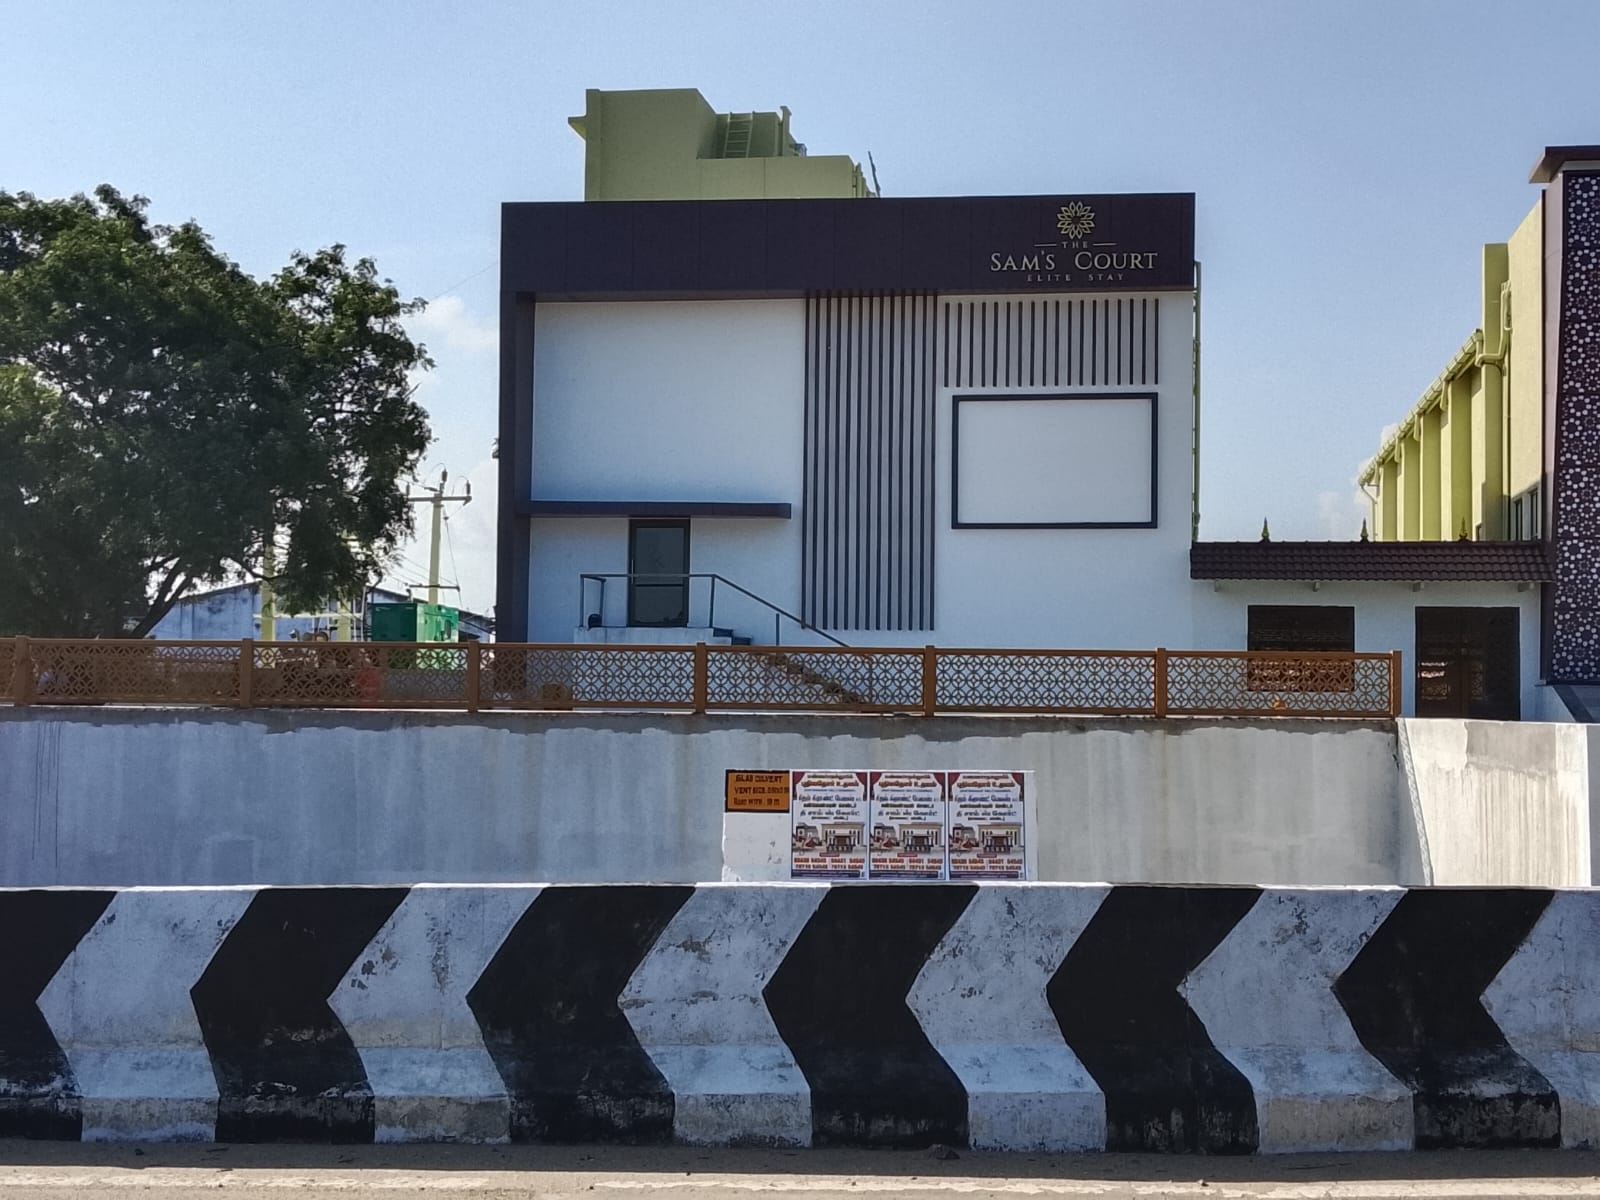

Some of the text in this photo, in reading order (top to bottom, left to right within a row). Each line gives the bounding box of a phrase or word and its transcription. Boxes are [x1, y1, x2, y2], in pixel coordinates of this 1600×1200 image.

[1062, 241, 1088, 249] THE
[990, 250, 1158, 271] SAM'S COURT
[1027, 273, 1124, 282] ELITE STAY
